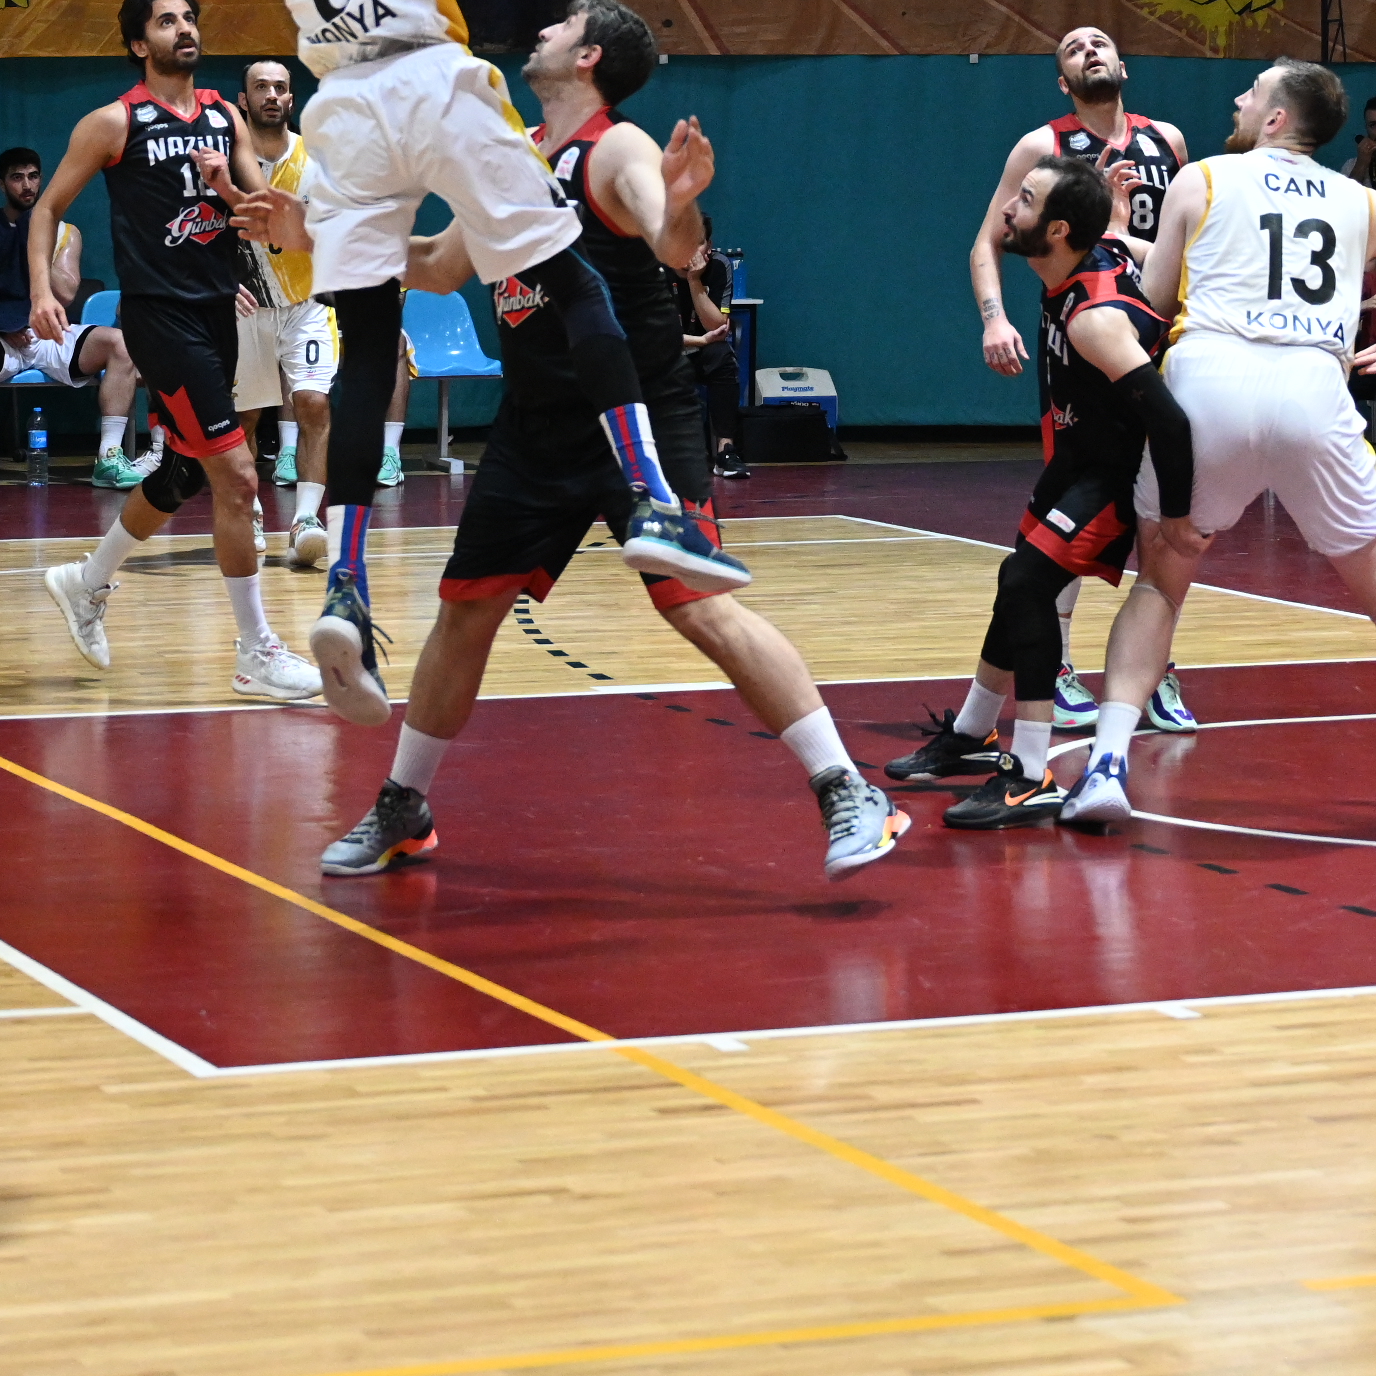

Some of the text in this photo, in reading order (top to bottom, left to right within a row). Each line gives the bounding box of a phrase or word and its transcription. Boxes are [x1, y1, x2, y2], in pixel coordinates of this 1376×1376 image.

[1264, 173, 1326, 198] CAN
[1259, 212, 1337, 306] 13
[1246, 310, 1345, 347] KONYA
[305, 339, 320, 365] 0
